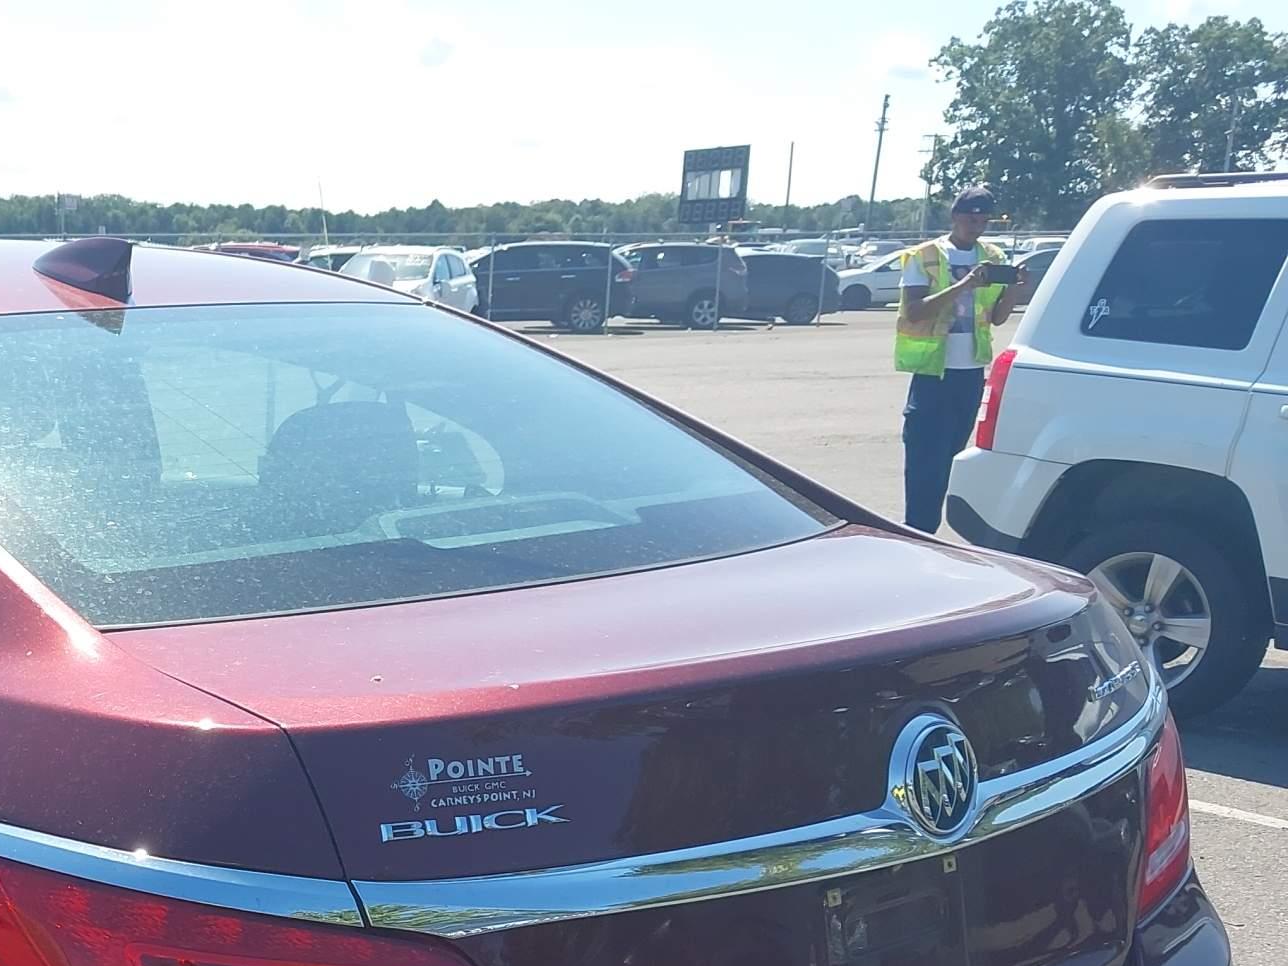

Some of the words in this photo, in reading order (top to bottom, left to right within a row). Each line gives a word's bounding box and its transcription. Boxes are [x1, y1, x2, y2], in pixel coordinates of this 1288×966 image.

[427, 754, 524, 781] POINTE
[452, 783, 480, 793] BUICK
[484, 781, 506, 791] GMC
[522, 789, 536, 799] NJ
[380, 804, 571, 843] BUICK
